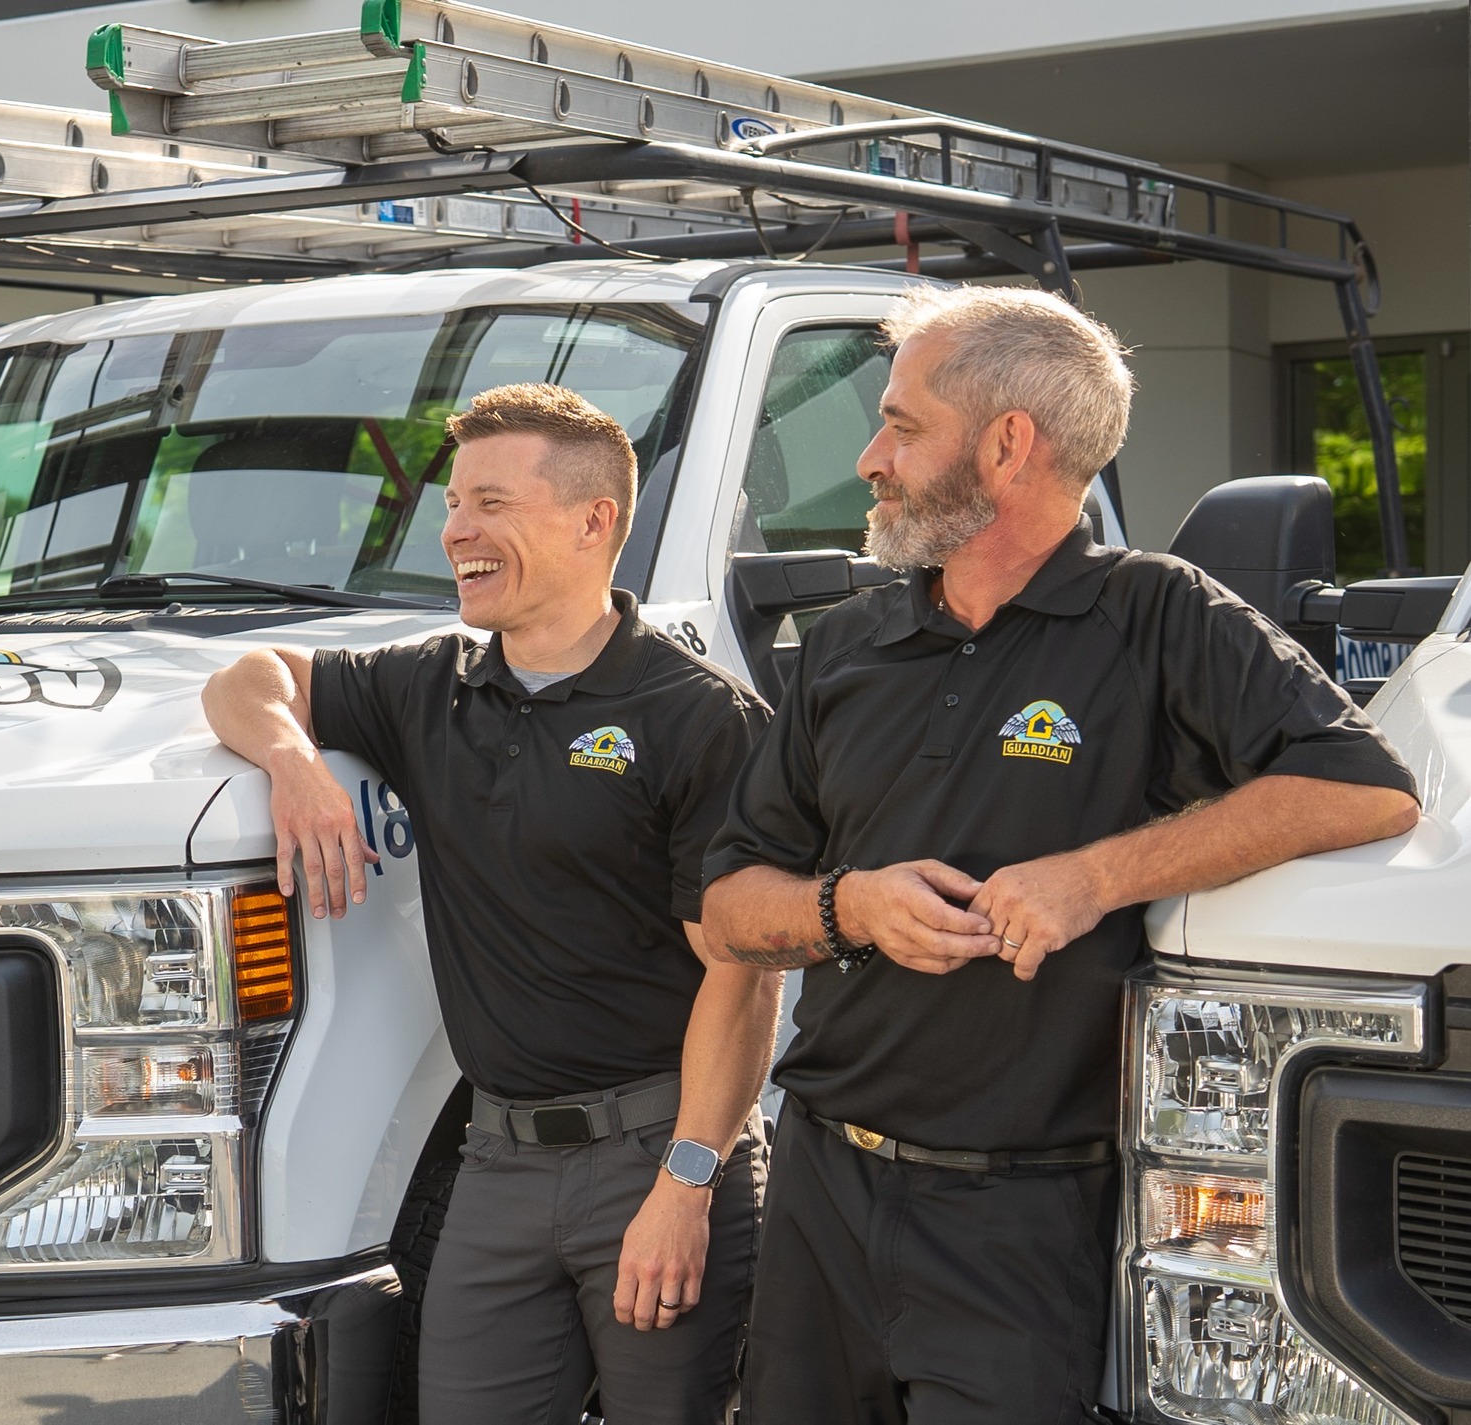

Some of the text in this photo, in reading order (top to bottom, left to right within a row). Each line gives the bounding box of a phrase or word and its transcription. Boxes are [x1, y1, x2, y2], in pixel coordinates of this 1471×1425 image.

[666, 620, 707, 656] 68
[1006, 742, 1069, 760] GUARDIAN
[573, 754, 624, 771] GUARDIAN
